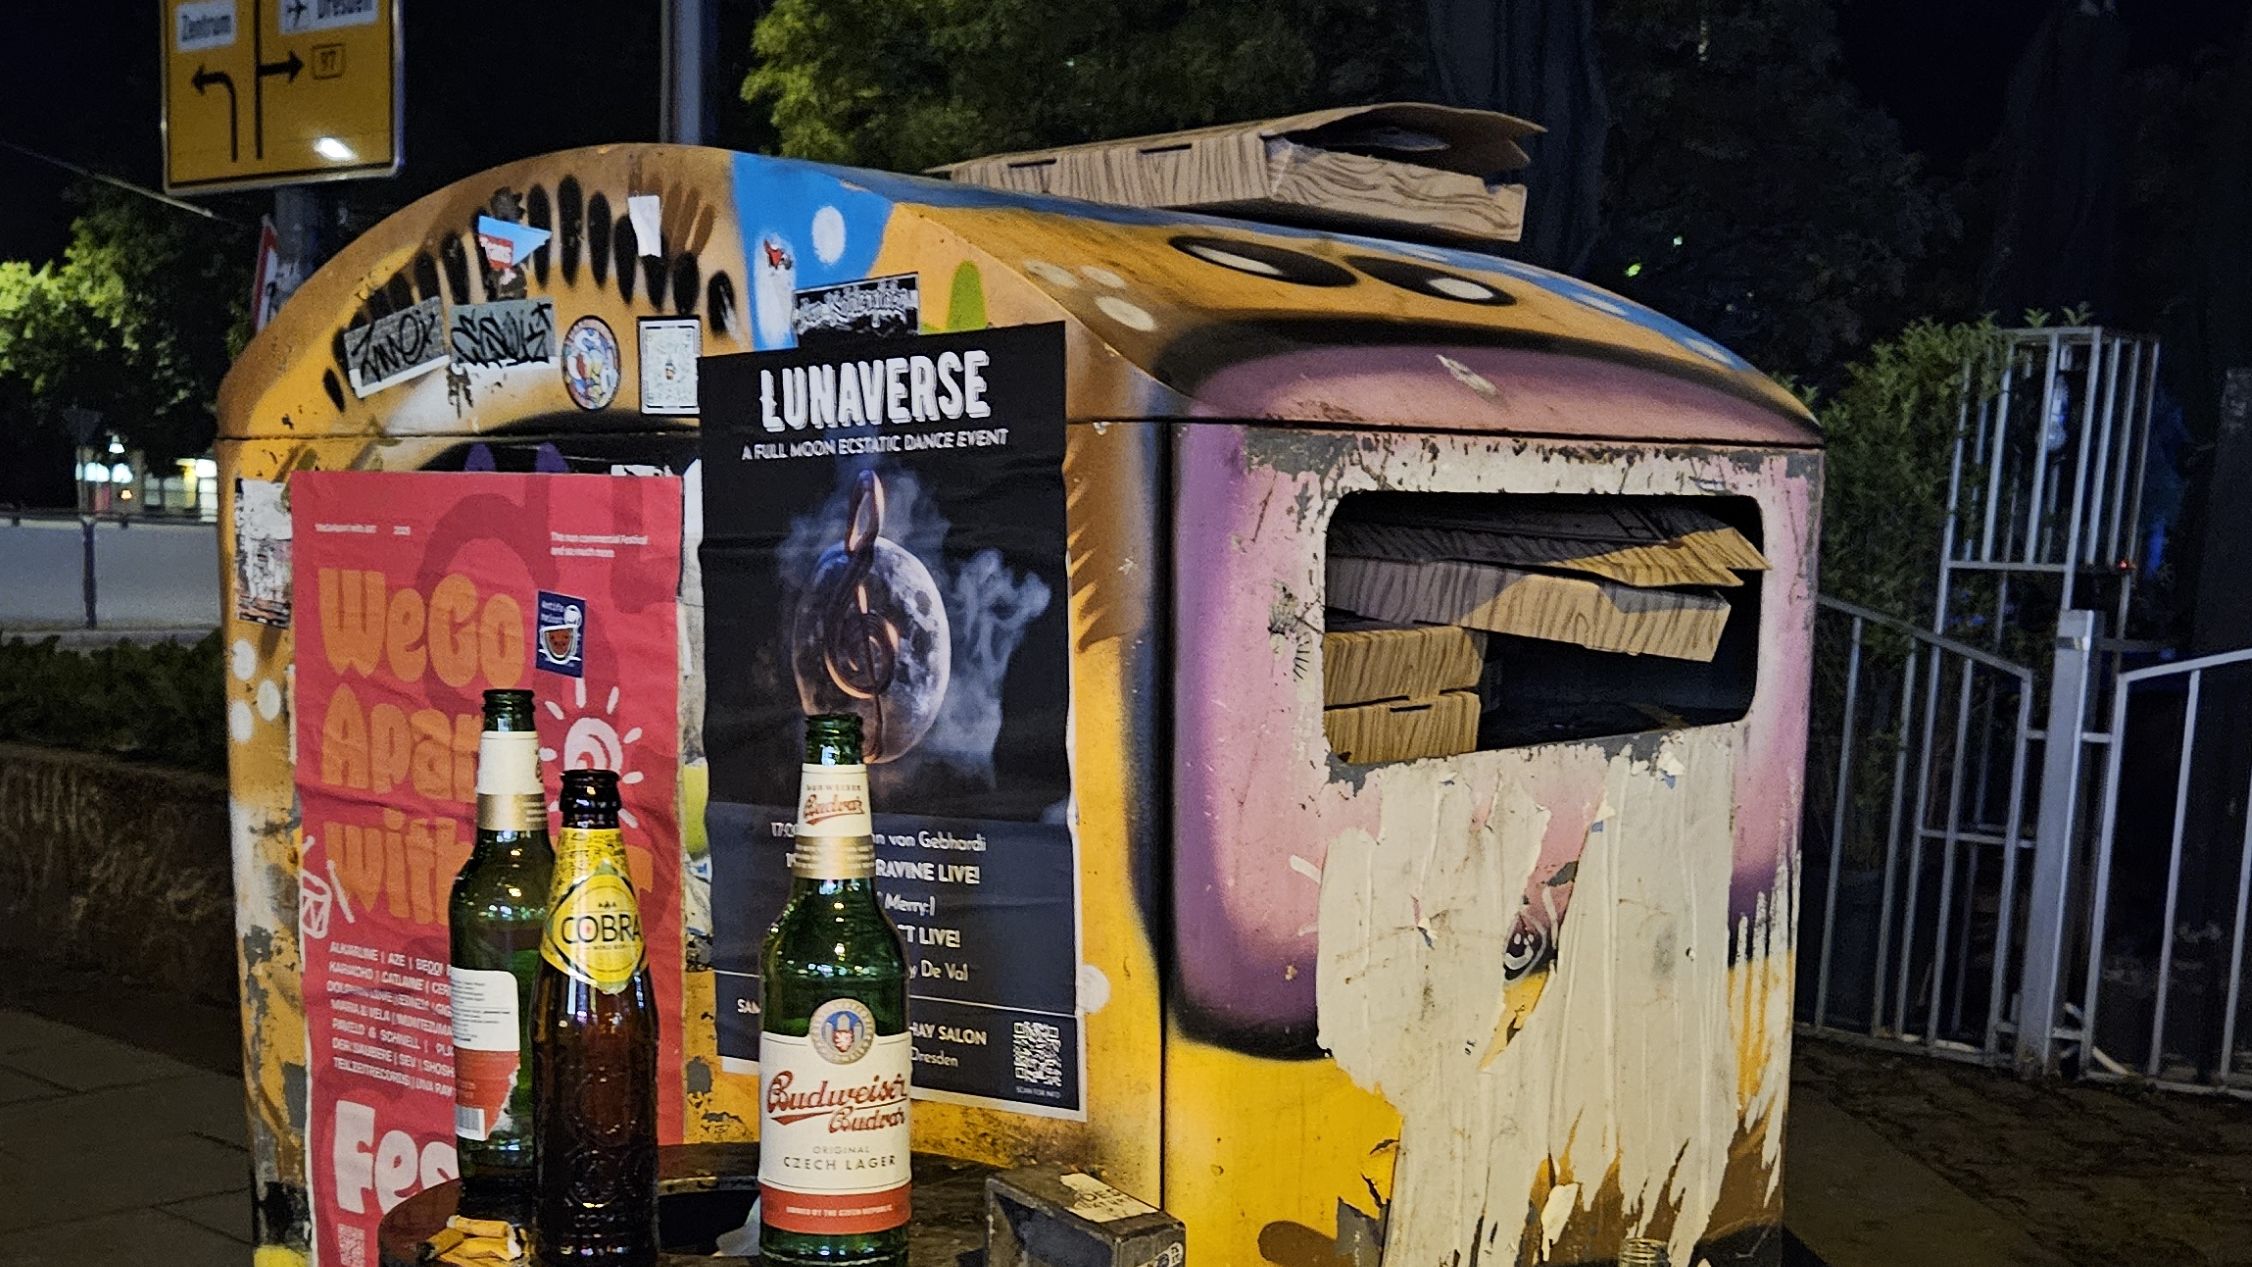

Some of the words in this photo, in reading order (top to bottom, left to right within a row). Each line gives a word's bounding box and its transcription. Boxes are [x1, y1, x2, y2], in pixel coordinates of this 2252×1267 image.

[759, 350, 991, 433] LUNAVERSE
[741, 446, 754, 460] A
[754, 442, 789, 459] FULL
[790, 439, 836, 458] MOON
[838, 435, 901, 455] ECSTATIC
[903, 431, 955, 451] DANCE
[956, 428, 1009, 448] EVENT
[938, 862, 980, 885] LIVE!
[561, 914, 641, 944] COBRA
[918, 926, 961, 948] LIVE!
[920, 959, 942, 979] De
[938, 1025, 987, 1046] SALON
[911, 1046, 959, 1068] Dresden
[812, 1145, 870, 1155] ORIGINAL
[783, 1156, 837, 1171] CZECH
[845, 1155, 896, 1170] LAGER
